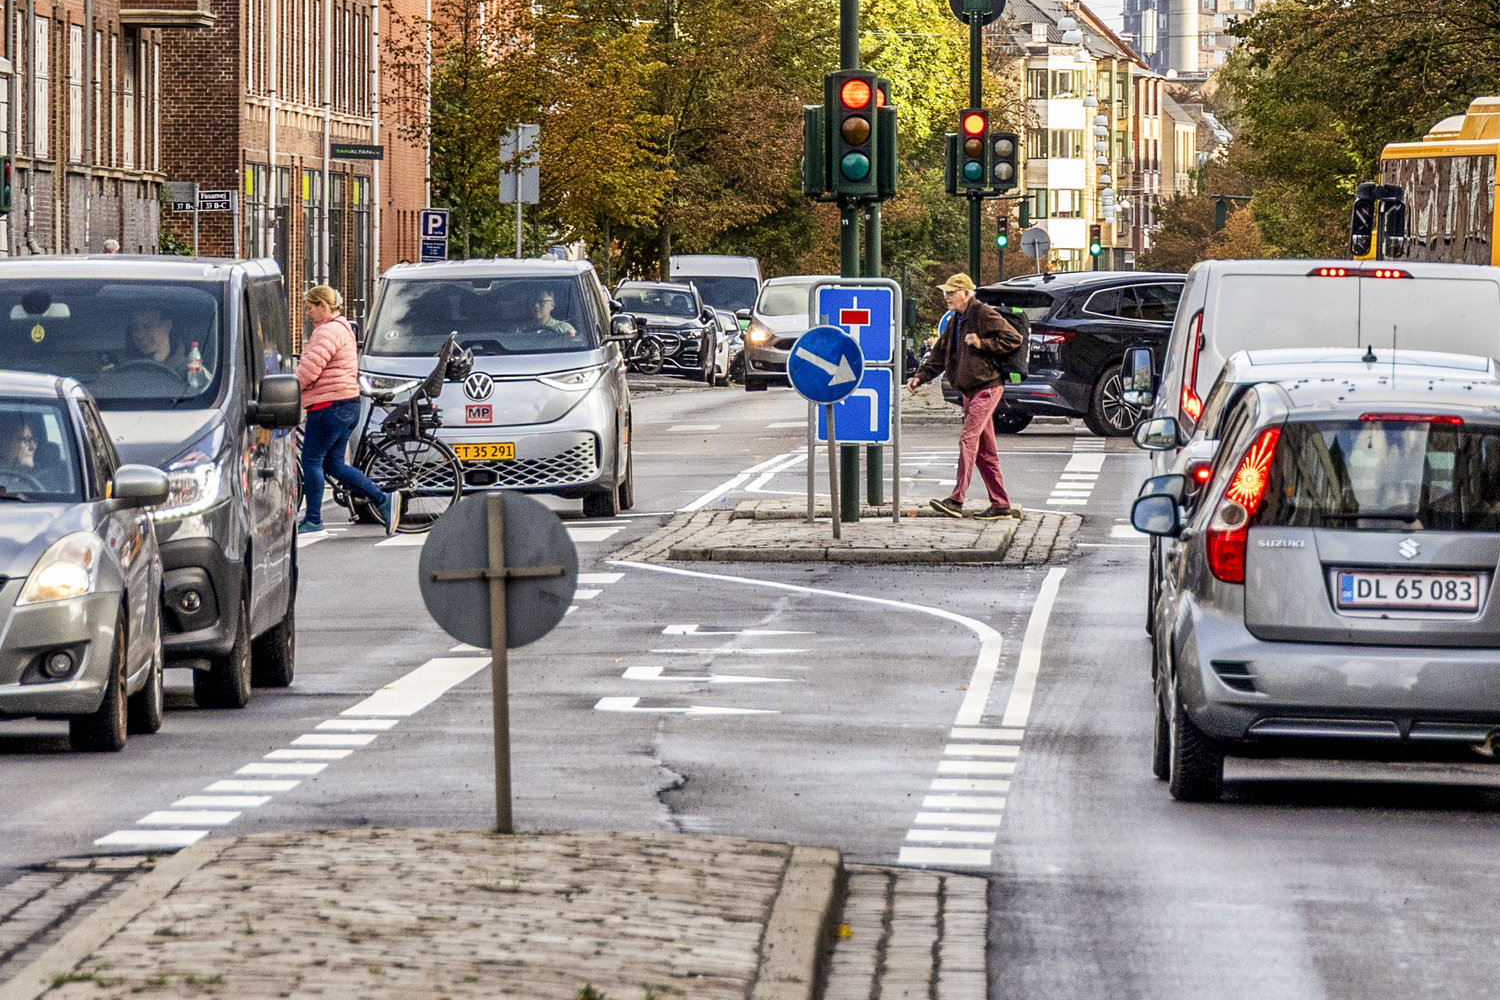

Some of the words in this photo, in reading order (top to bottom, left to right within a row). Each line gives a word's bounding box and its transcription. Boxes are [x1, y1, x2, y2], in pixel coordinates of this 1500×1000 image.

[428, 214, 443, 235] P
[468, 408, 490, 418] MP
[454, 446, 470, 458] ET
[473, 446, 487, 457] 35
[491, 445, 512, 457] 291
[1257, 540, 1305, 548] SUZUKI
[1357, 579, 1387, 599] DL
[1395, 578, 1423, 600] 65
[1430, 580, 1472, 601] 083
